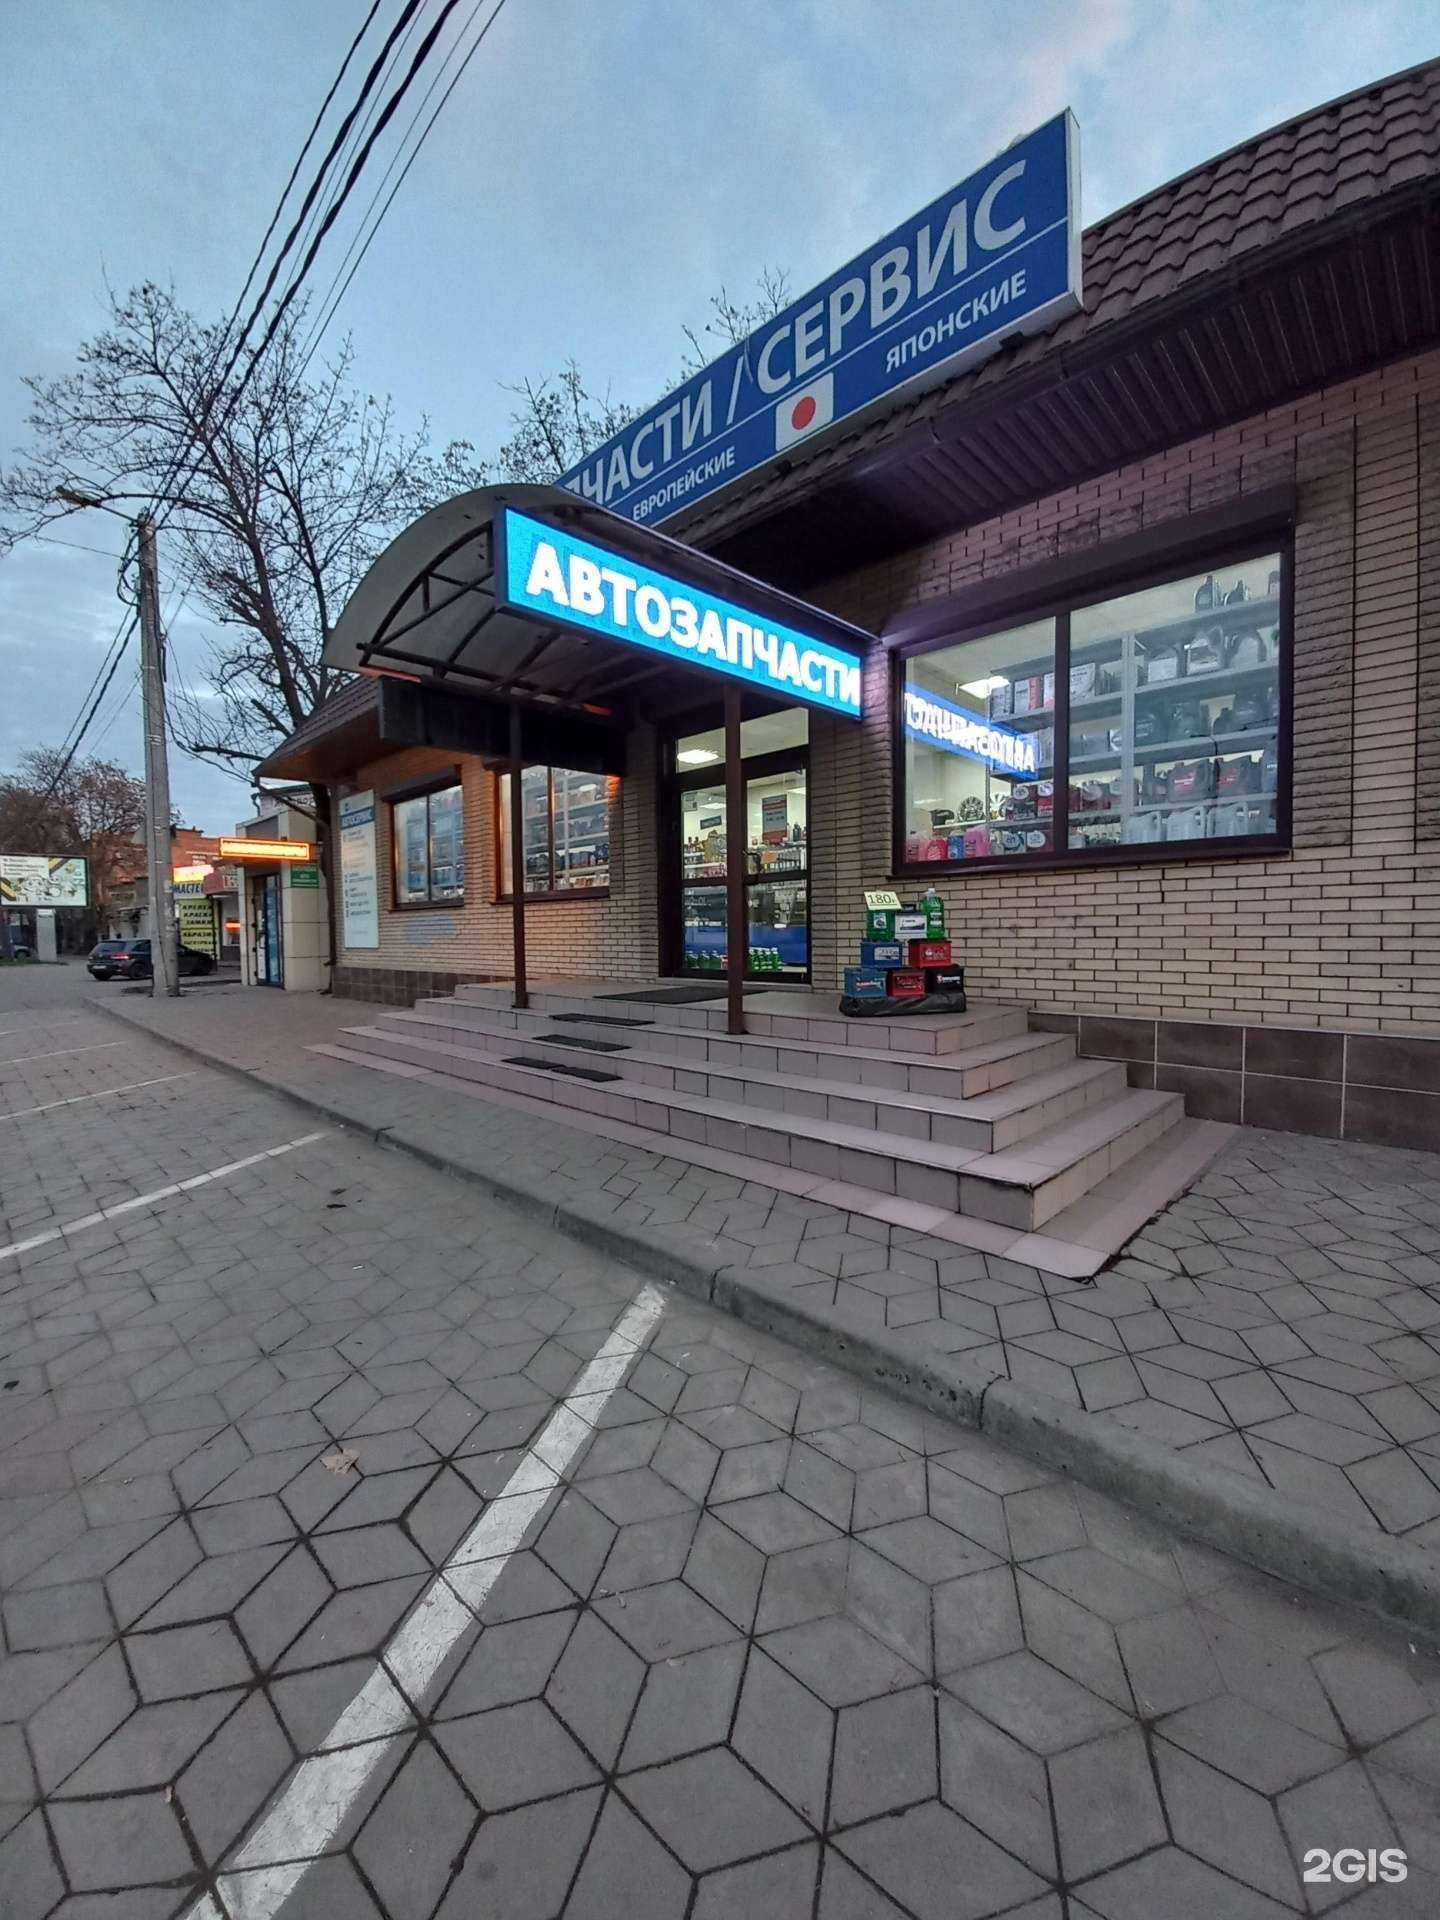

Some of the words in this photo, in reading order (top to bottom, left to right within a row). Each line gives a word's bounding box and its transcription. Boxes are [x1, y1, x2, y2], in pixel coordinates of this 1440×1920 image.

[757, 159, 1027, 394] СЕРВИС
[886, 269, 1027, 375] ЯПОНСКИЕ
[632, 446, 735, 522] ЕВРОПЕЙСКИЕ
[525, 541, 861, 706] АВТОЗАПЧАСТИ
